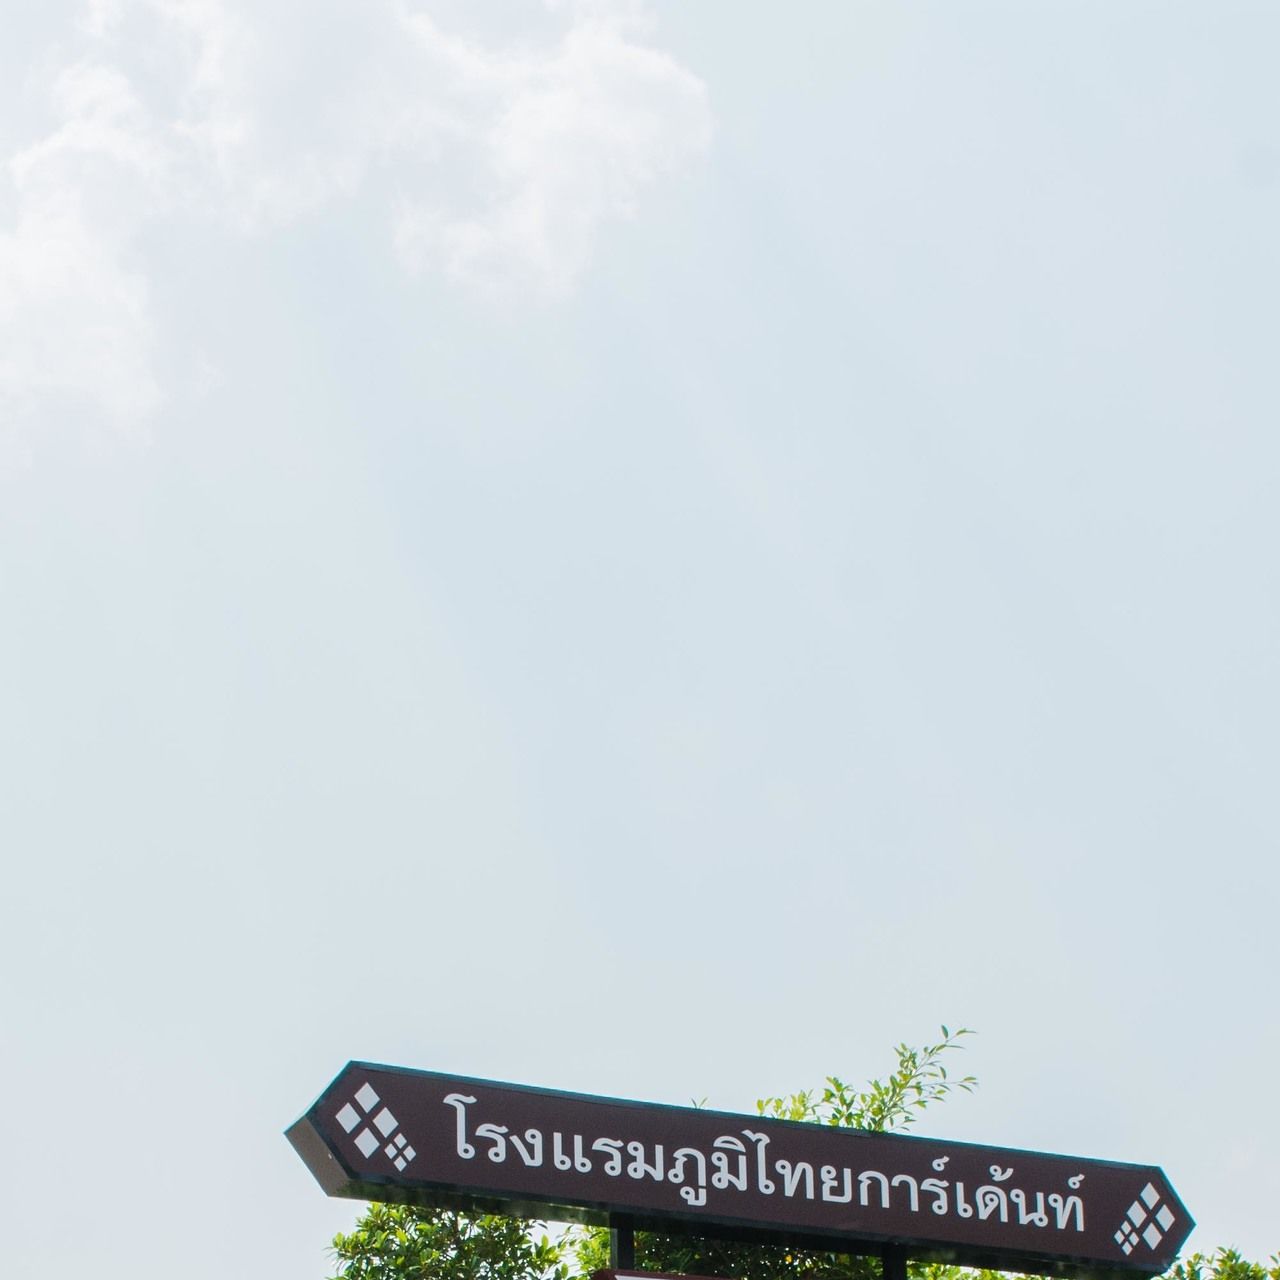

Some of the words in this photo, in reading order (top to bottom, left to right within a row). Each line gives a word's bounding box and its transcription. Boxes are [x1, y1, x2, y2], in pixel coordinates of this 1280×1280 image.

[442, 1092, 1086, 1233] โรงแรมภูมิไทยการ์เด้นท์
